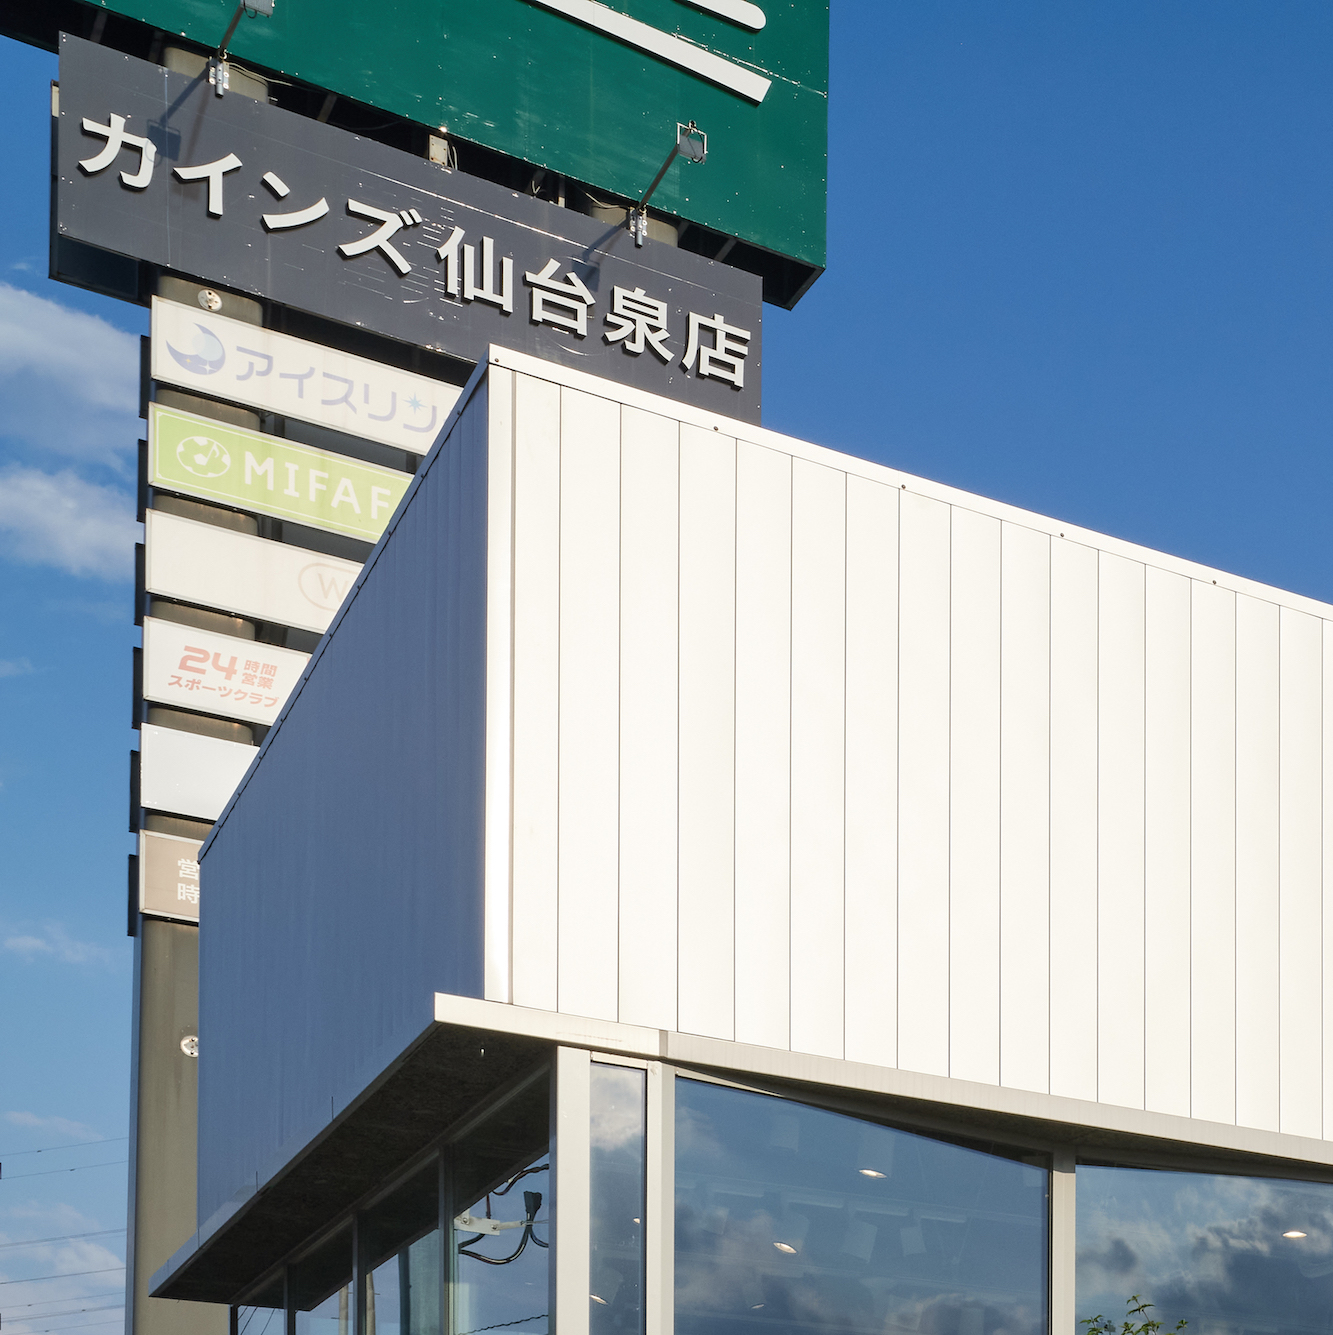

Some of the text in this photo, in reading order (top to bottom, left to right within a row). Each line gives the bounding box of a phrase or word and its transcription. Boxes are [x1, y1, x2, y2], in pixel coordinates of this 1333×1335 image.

[78, 112, 753, 391] カインズ仙台泉店
[244, 450, 392, 521] MIFAF
[178, 645, 278, 681] 24 時間
[241, 671, 275, 691] 営業
[167, 673, 280, 708] スポーツクラブ
